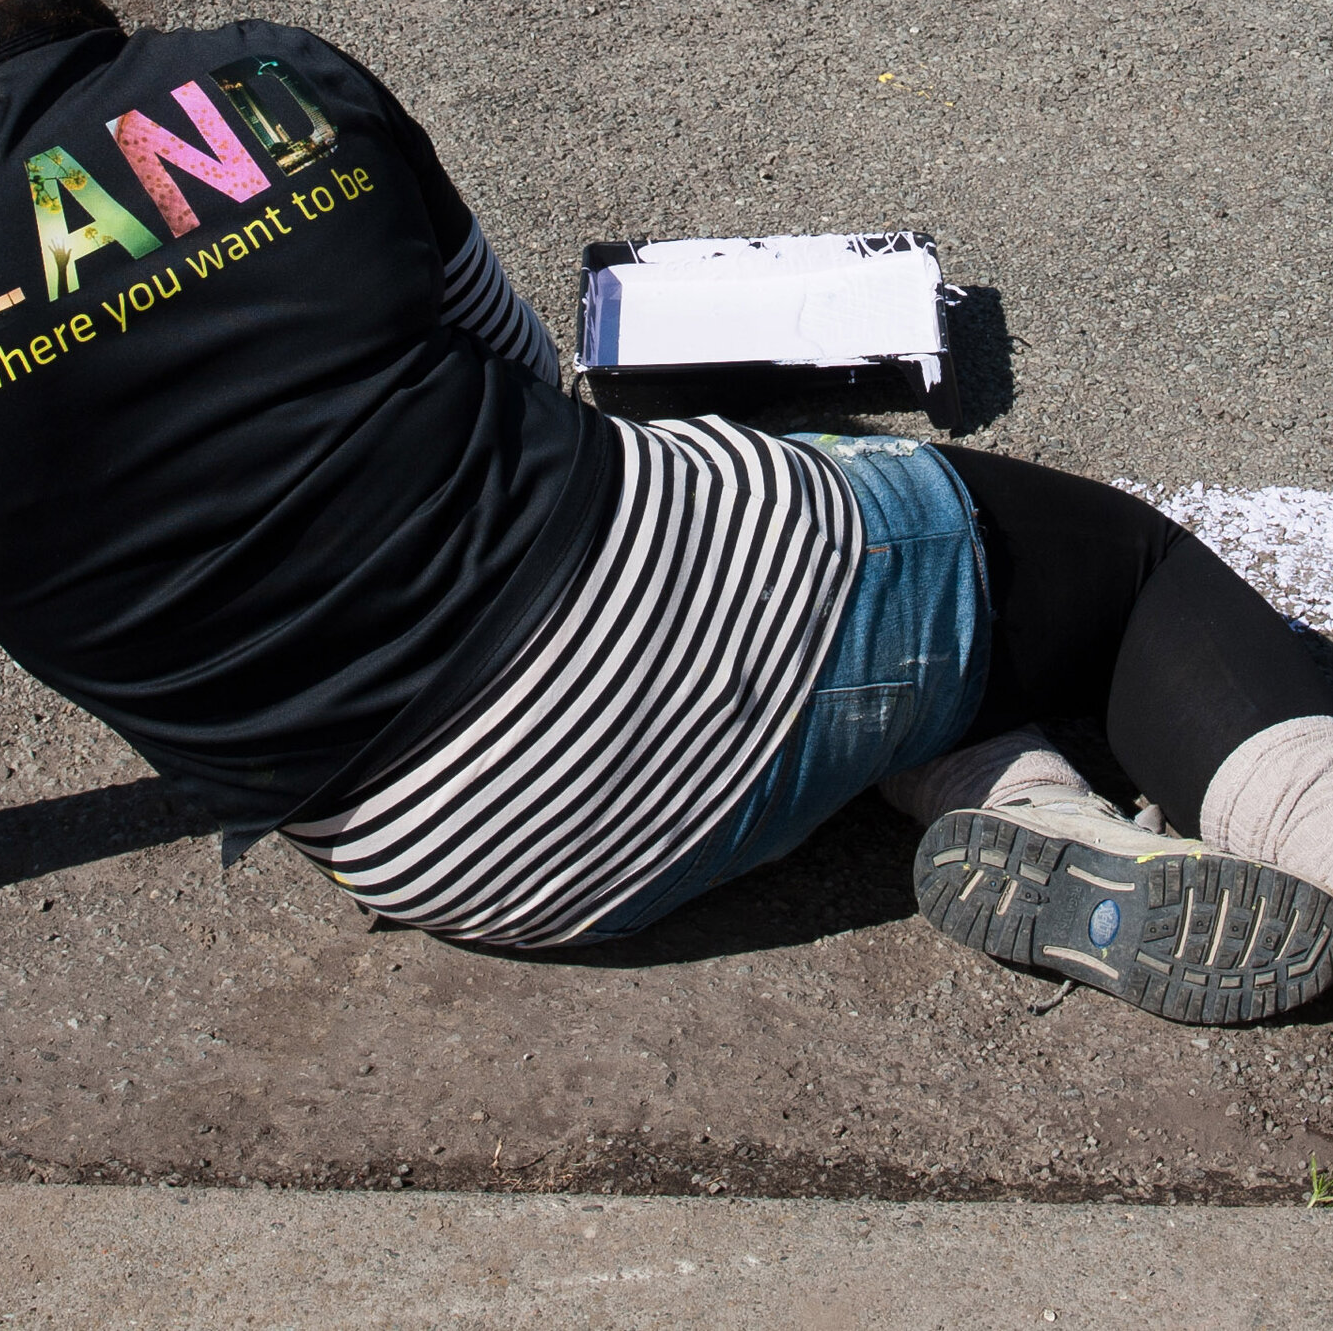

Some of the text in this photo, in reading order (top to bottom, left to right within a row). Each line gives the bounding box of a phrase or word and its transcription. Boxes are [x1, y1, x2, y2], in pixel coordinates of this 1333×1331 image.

[101, 267, 182, 333] you
[185, 207, 292, 279] want
[292, 185, 335, 221] to
[334, 163, 374, 202] be
